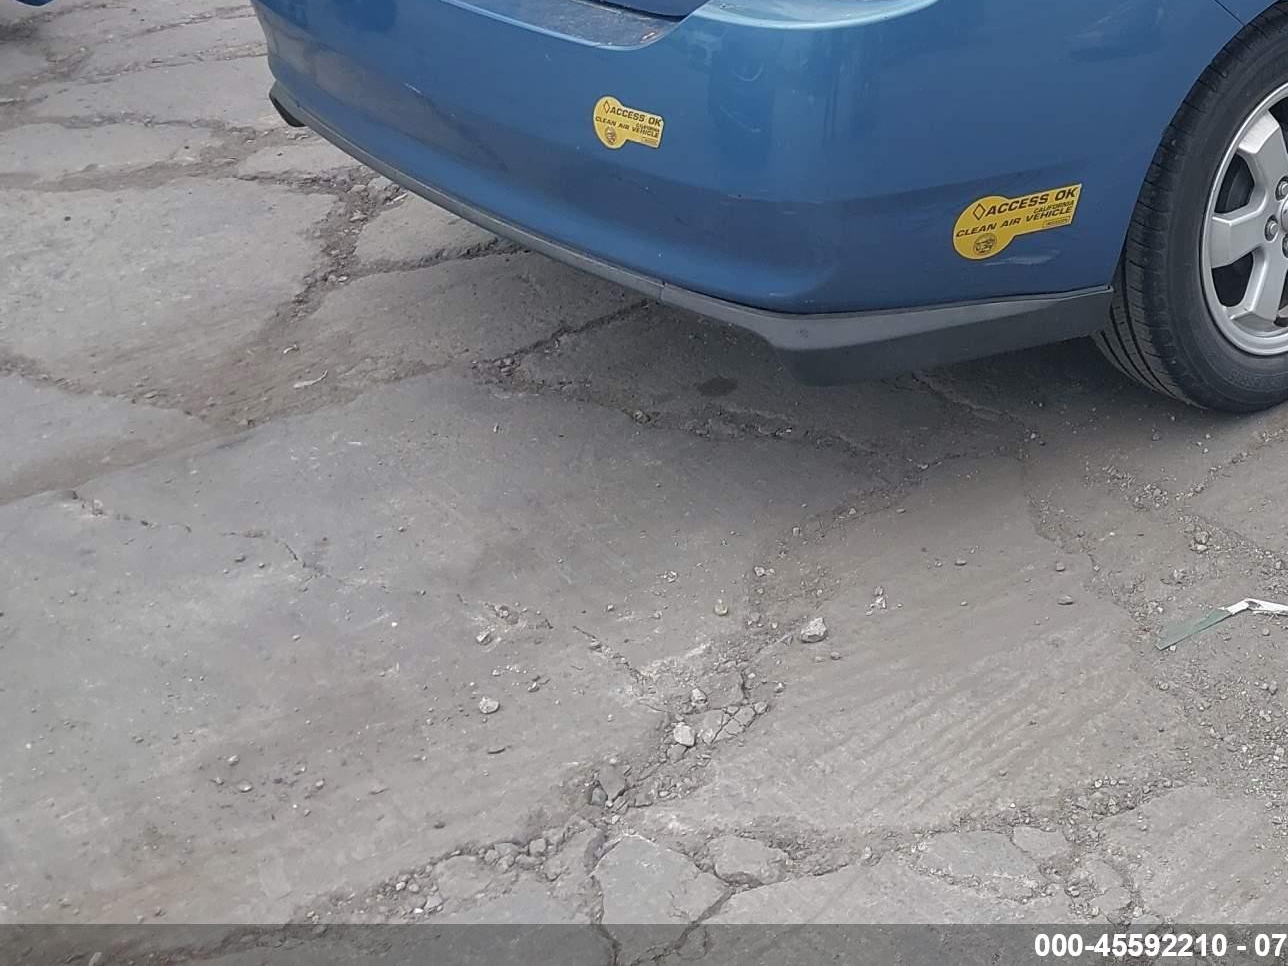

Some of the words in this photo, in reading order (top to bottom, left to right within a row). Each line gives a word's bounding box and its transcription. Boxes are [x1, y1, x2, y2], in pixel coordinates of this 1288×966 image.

[595, 116, 617, 127] CLEAN
[618, 122, 630, 131] AIR
[632, 127, 660, 139] VEHICLE
[609, 106, 646, 123] ACCESS
[648, 116, 661, 128] OK
[985, 193, 1049, 217] ACCESS
[1054, 186, 1078, 202] OK
[1033, 200, 1075, 215] CALIFORNIA
[956, 222, 997, 238] CLEAN
[1000, 217, 1022, 229] AIR
[1026, 207, 1073, 223] VEHICLE
